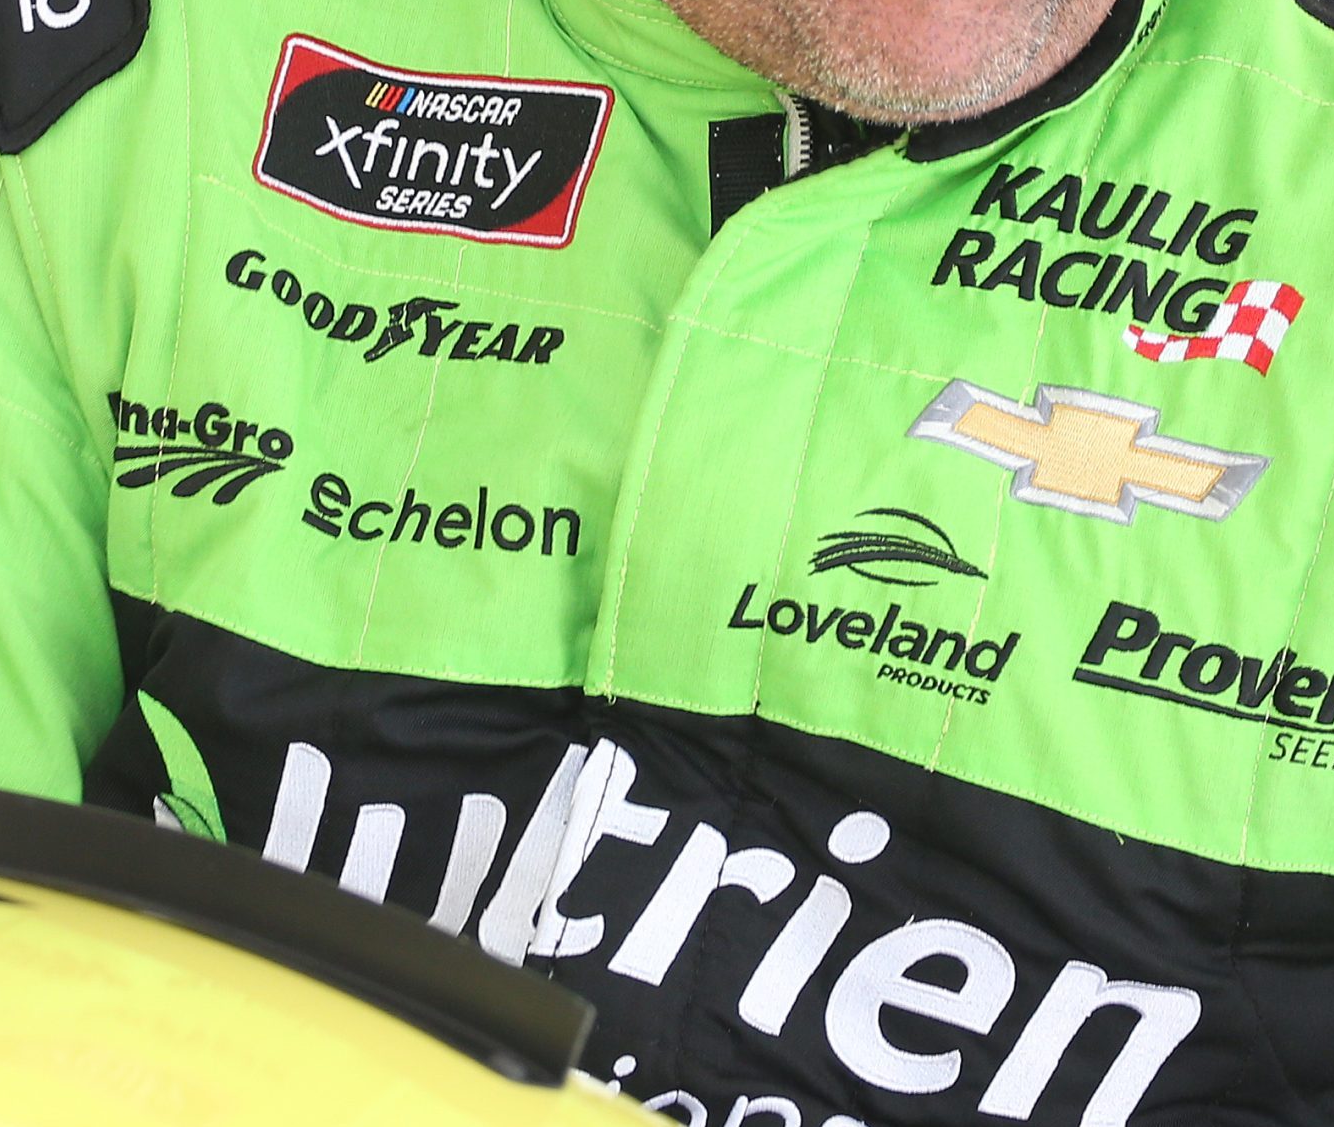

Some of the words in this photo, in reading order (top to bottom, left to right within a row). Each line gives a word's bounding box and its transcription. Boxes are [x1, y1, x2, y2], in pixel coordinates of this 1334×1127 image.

[405, 88, 522, 126] NASCAR
[315, 115, 543, 210] xfinity
[375, 185, 472, 219] SERIES
[971, 163, 1259, 266] KAULIG
[931, 228, 1229, 334] RACING
[302, 473, 582, 556] echelon
[728, 583, 1021, 682] Loveland
[877, 663, 991, 706] PRODUCTS
